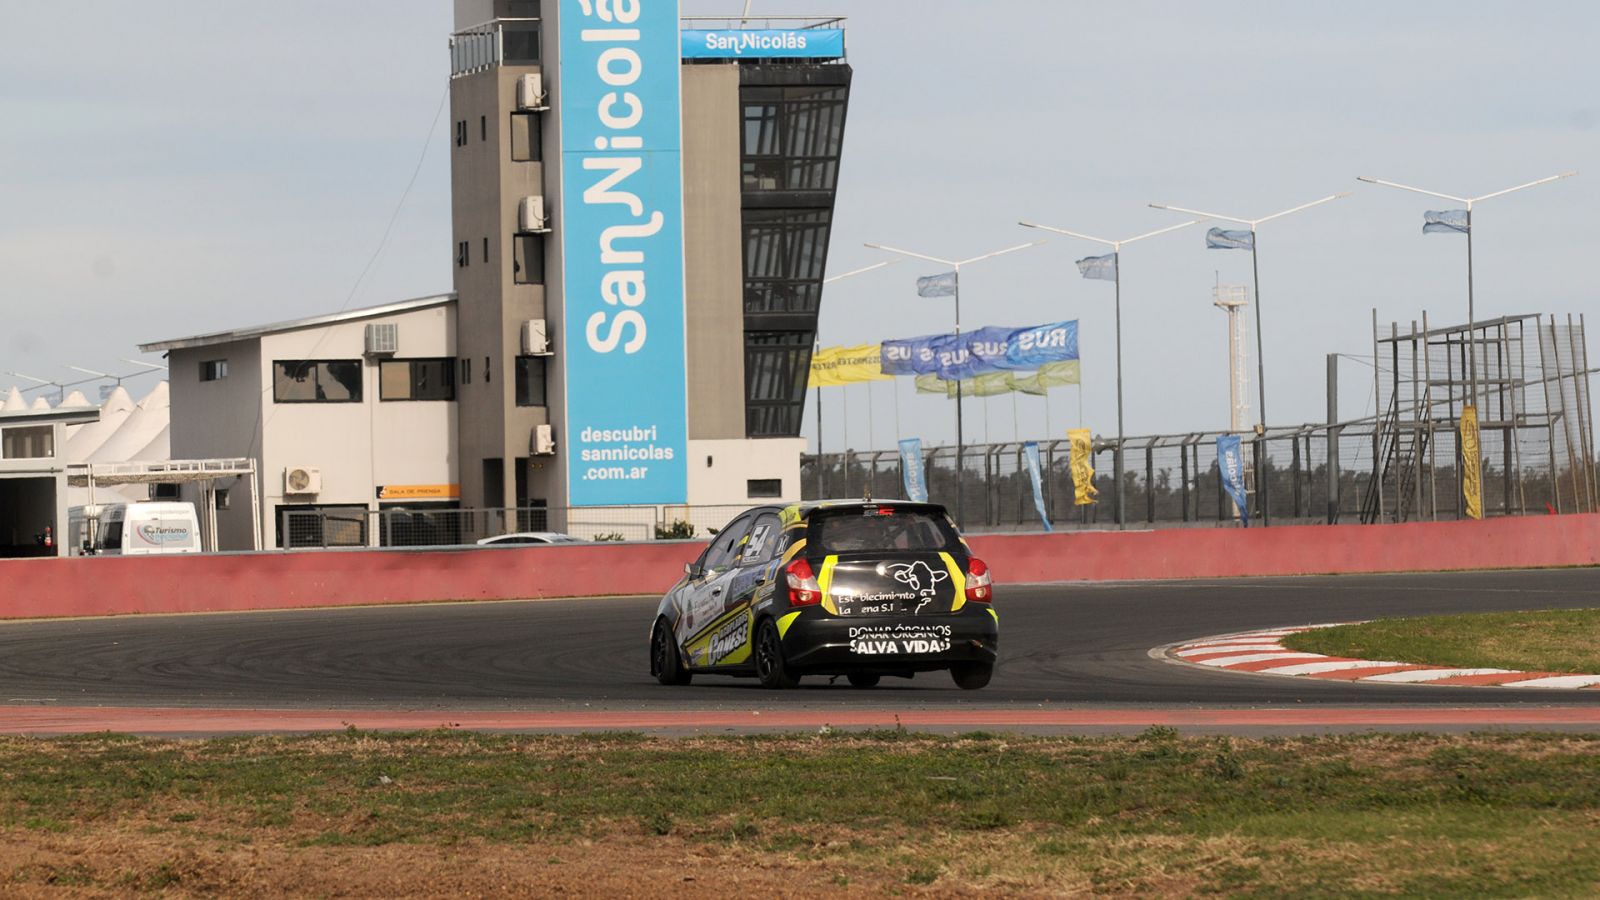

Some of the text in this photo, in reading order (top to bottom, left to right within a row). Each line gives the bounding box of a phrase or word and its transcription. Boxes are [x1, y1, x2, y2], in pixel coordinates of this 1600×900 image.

[580, 425, 657, 442] descubri
[581, 444, 674, 461] sannicolas
[582, 466, 648, 480] .com.ar
[155, 526, 187, 534] Turismo
[838, 591, 916, 604] Estbleciminto
[849, 623, 952, 640] DONAR ÓRGANOS
[849, 637, 951, 655] SALVA VIDAS
